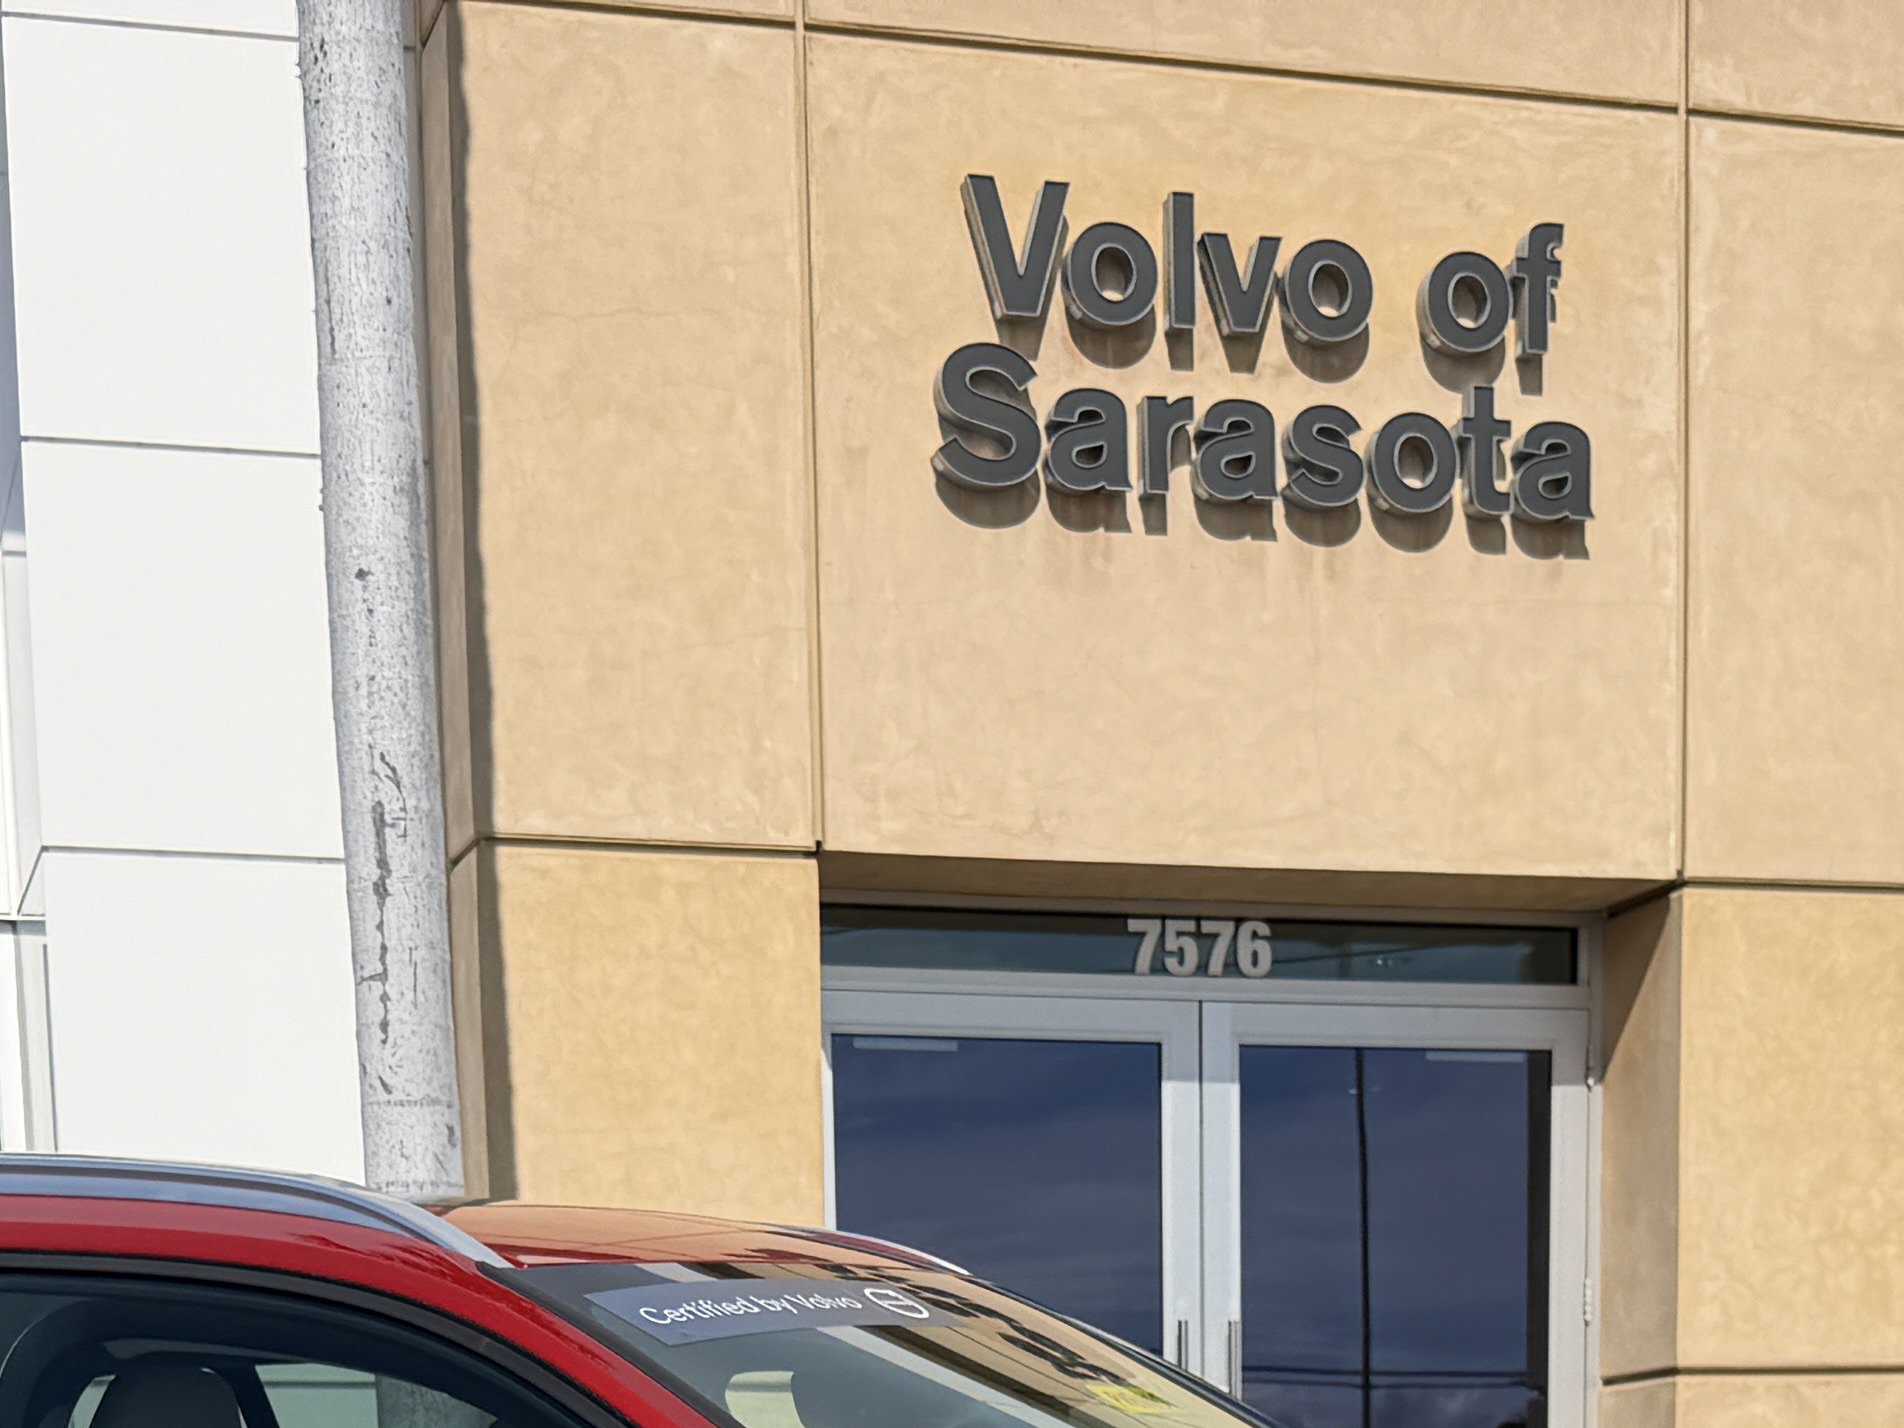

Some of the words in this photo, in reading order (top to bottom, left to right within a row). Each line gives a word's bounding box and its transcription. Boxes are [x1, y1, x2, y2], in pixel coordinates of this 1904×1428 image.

[960, 173, 1373, 344] Volvo
[1416, 222, 1565, 357] of
[931, 342, 1596, 521] Sarasota
[1127, 918, 1272, 978] 7576
[640, 1297, 756, 1325] Certified
[753, 1295, 795, 1315] by
[787, 1294, 863, 1311] Volvo
